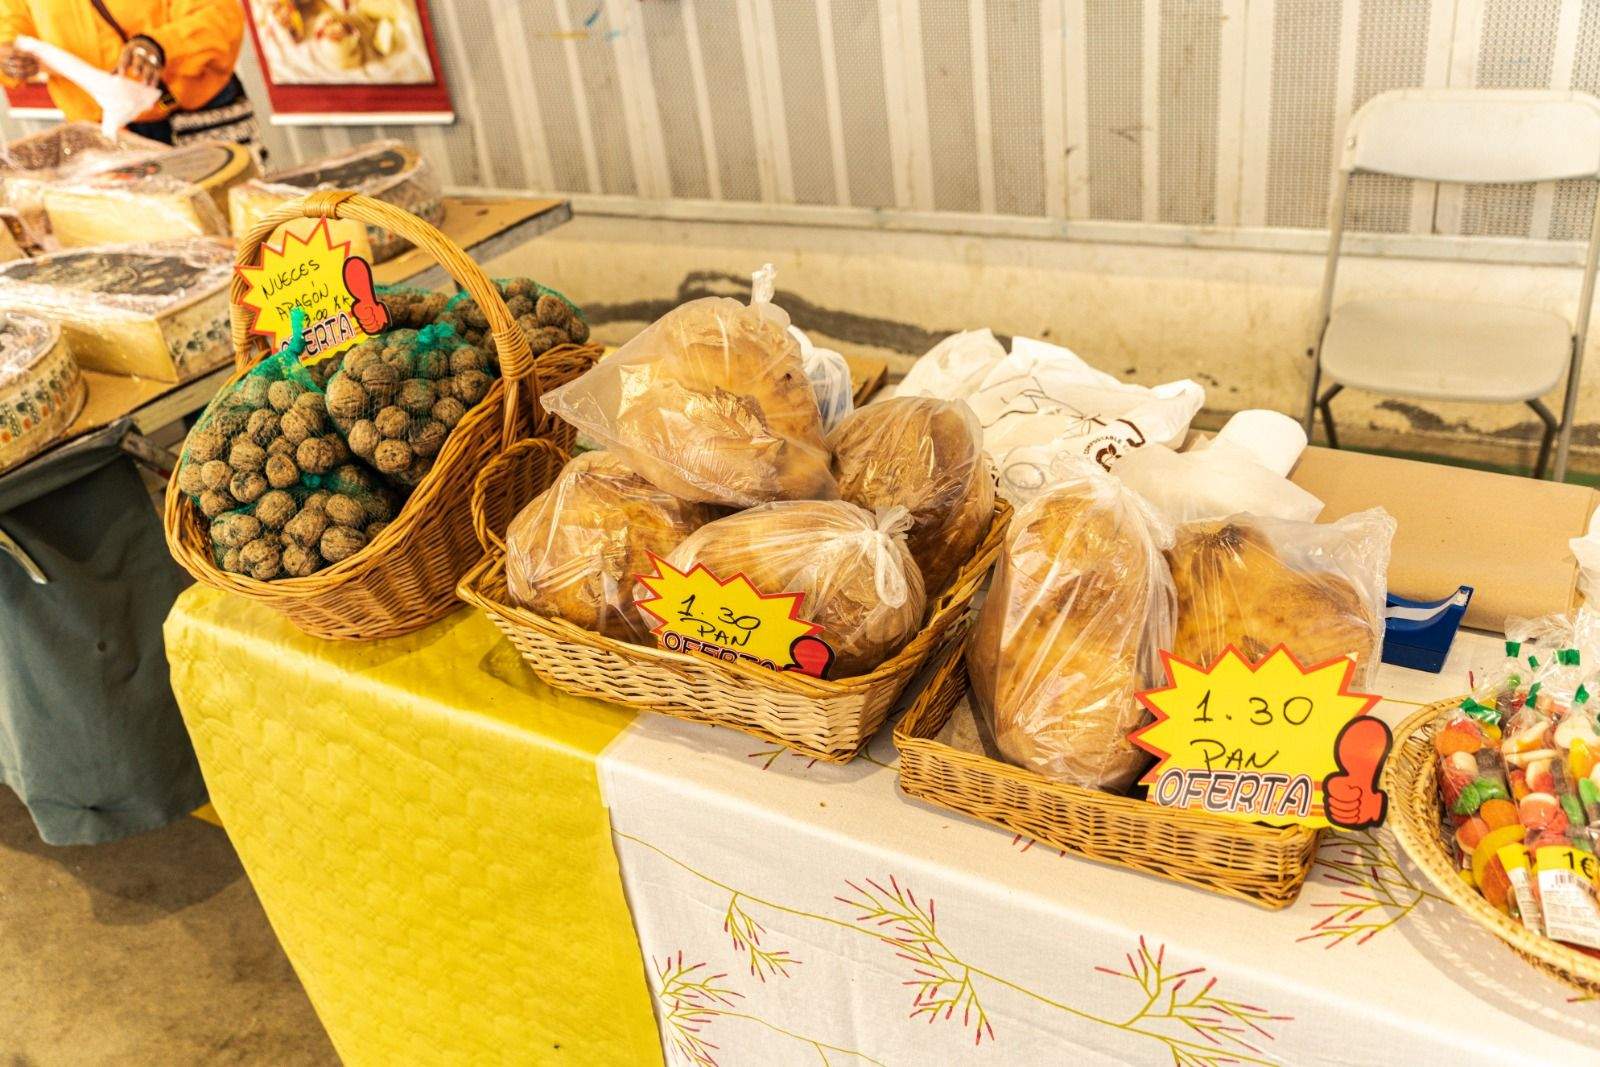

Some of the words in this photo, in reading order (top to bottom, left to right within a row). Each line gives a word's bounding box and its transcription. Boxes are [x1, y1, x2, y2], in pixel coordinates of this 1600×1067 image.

[261, 259, 320, 300] NUECES
[677, 594, 761, 630] 1.30
[680, 617, 751, 647] PAN
[1193, 690, 1313, 726] 1.30
[1190, 738, 1279, 775] PAN
[1155, 768, 1315, 817] OFERTA
